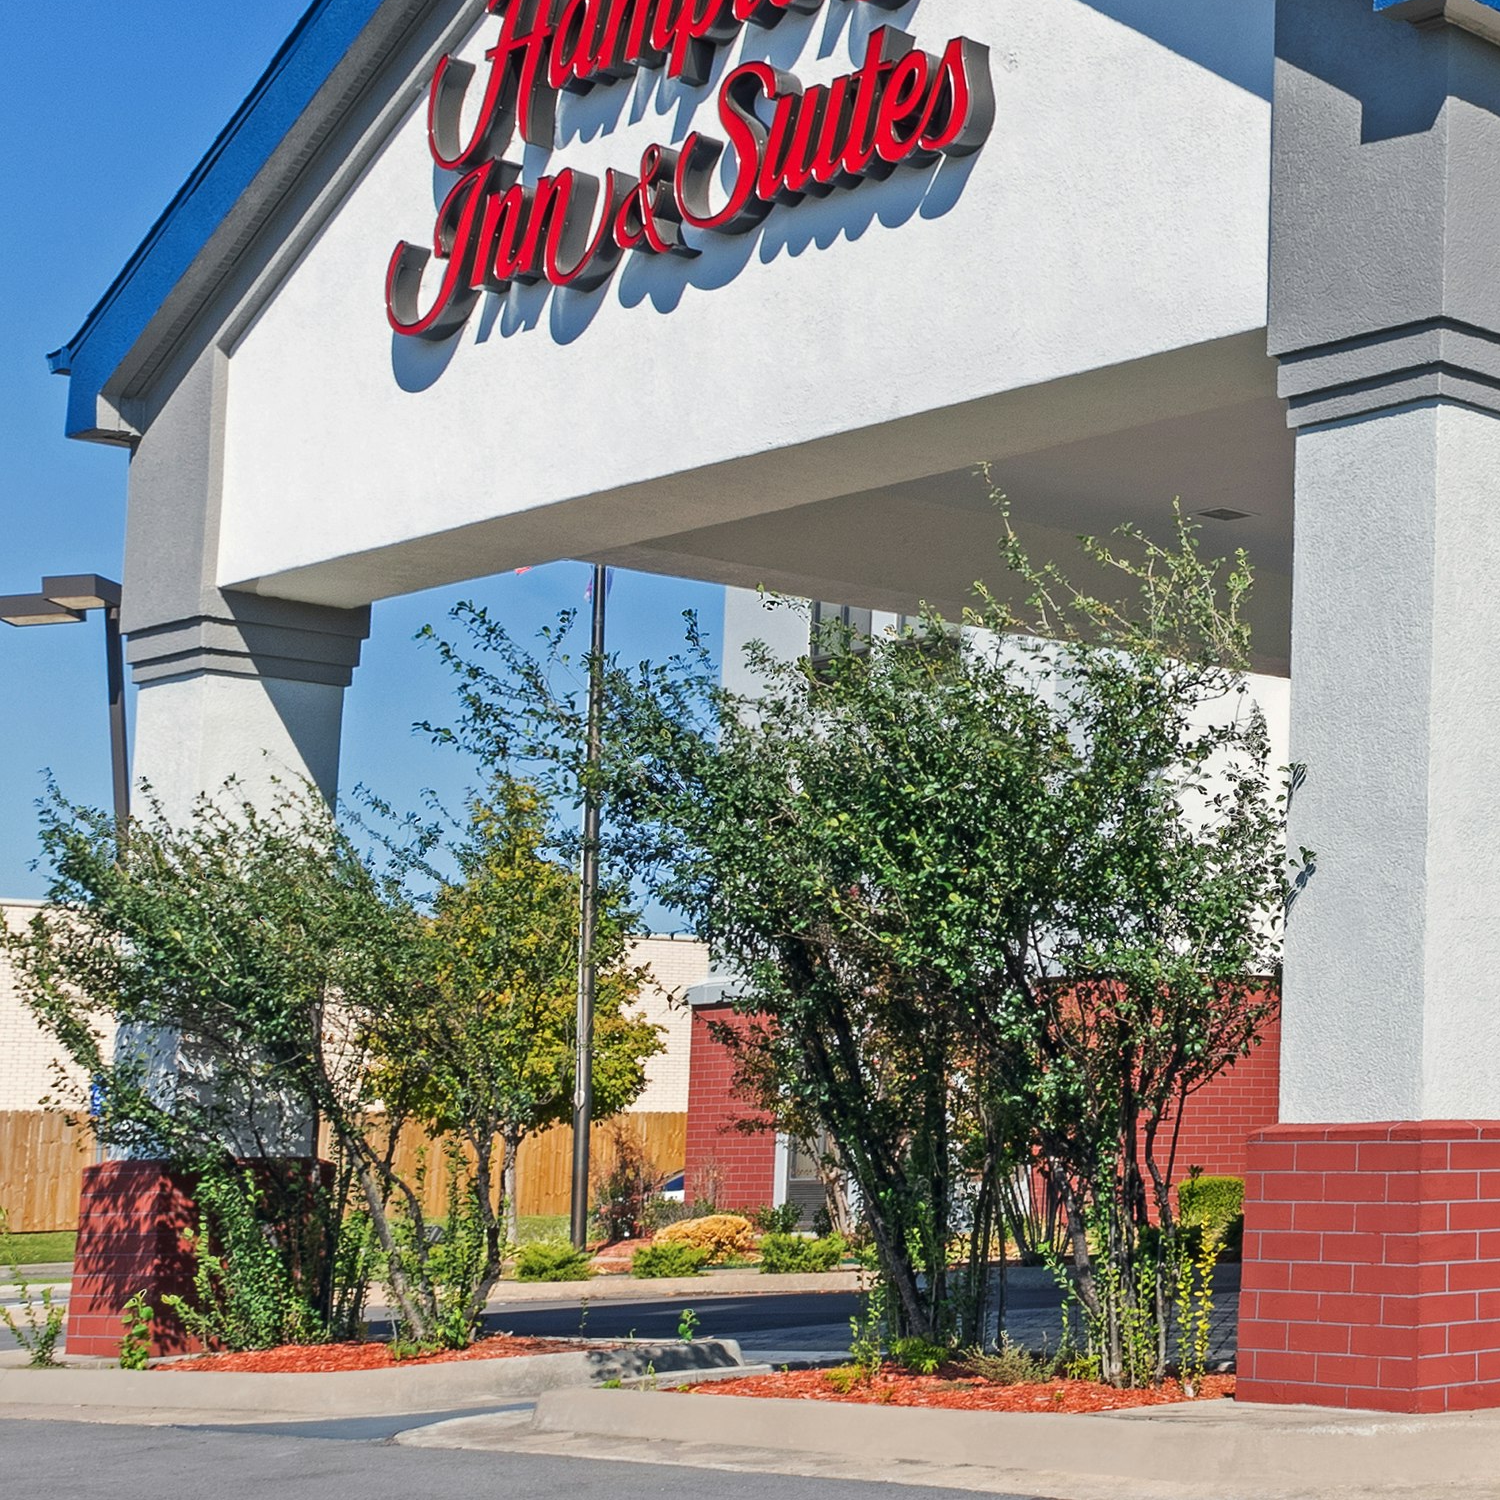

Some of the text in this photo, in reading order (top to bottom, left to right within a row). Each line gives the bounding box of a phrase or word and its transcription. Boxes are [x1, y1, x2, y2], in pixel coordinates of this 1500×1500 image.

[386, 25, 996, 338] Inn & Suites
